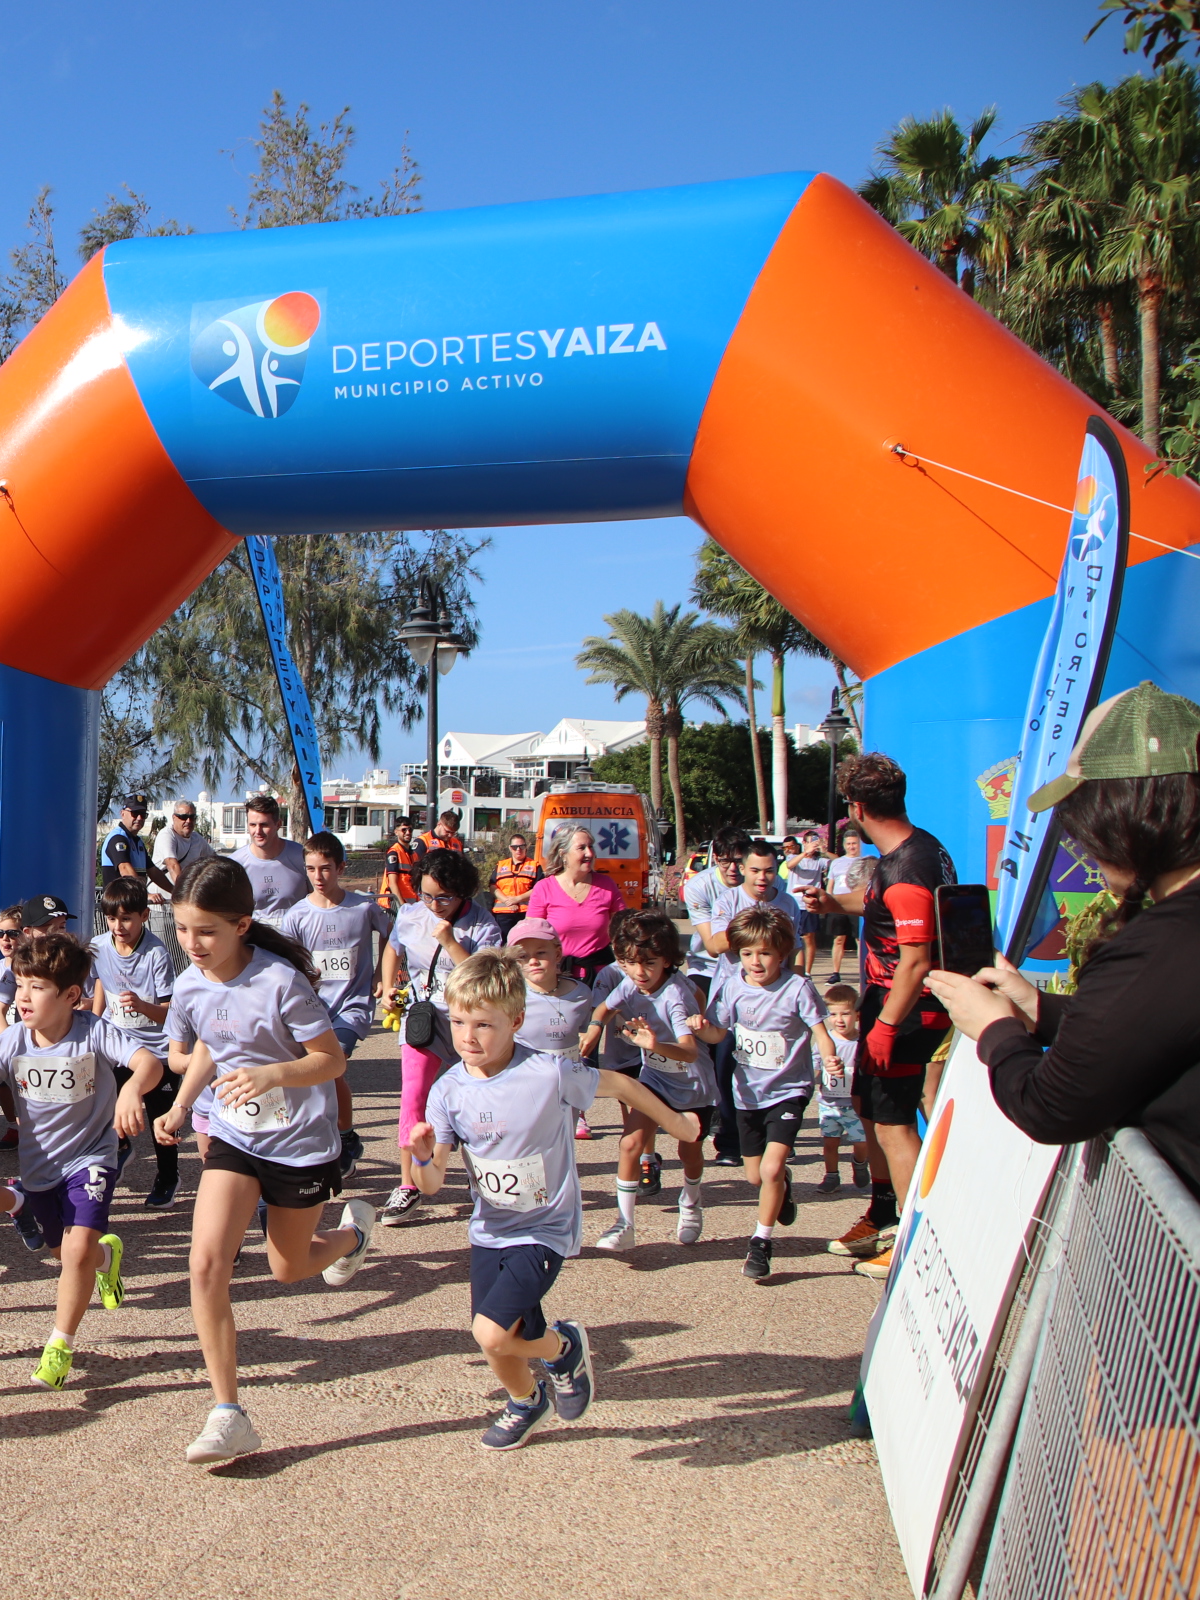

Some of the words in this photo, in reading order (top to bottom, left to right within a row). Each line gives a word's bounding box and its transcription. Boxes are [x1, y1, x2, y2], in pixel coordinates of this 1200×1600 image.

[332, 322, 667, 374] DEPORTESYAIZA
[334, 378, 449, 400] MUNICIPIO
[460, 372, 544, 391] ACTIVO
[550, 806, 635, 816] AMBULANCIA
[321, 956, 350, 972] 186
[737, 1034, 767, 1057] 030
[27, 1068, 76, 1090] 073
[298, 1185, 320, 1196] PUMA
[474, 1164, 521, 1197] 202
